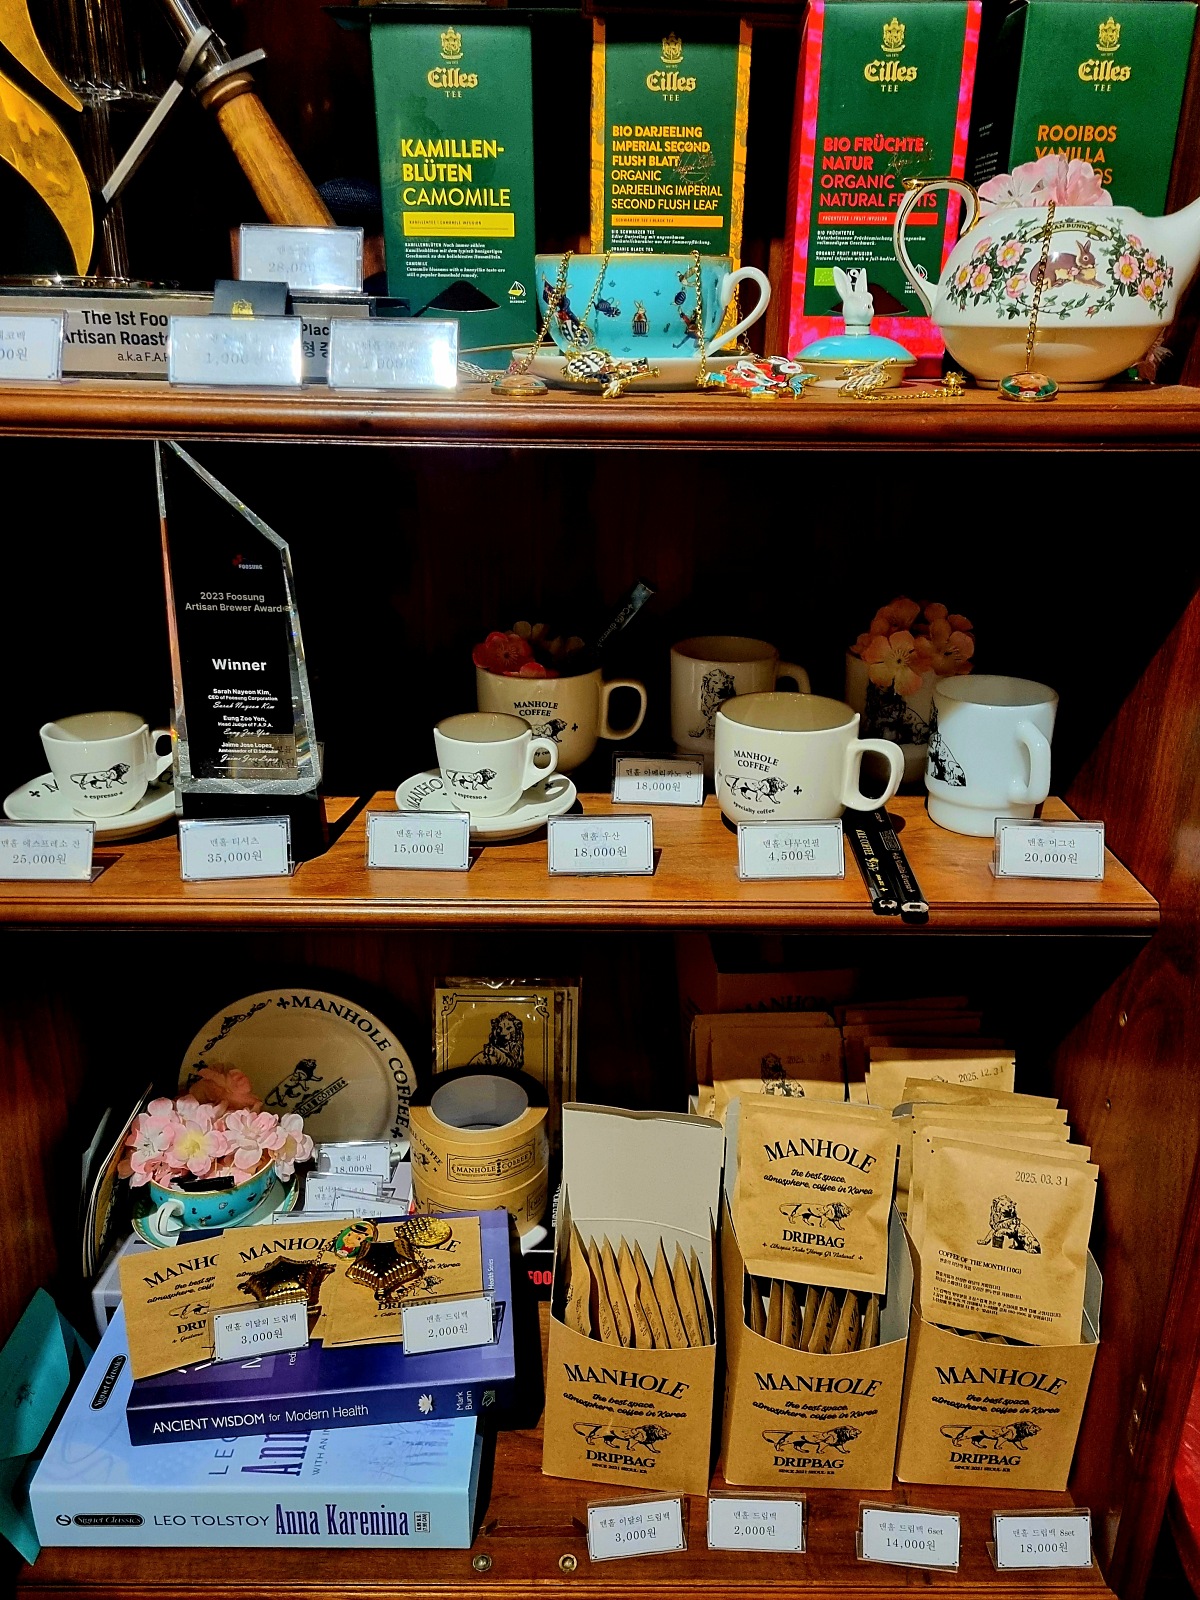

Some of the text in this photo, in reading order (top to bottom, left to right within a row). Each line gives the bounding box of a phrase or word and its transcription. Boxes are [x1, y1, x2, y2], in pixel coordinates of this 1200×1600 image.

[864, 60, 917, 82] Eilles
[1078, 59, 1131, 81] Eilles
[427, 67, 479, 88] Eilles
[646, 70, 697, 92] Eilles
[881, 84, 898, 92] TEE
[1094, 84, 1111, 92] TEE
[663, 94, 679, 102] TEE
[612, 126, 702, 138] BIO DARJEELING
[1037, 125, 1117, 141] ROOIBOS
[401, 139, 504, 158] KAMILLEN-
[612, 140, 710, 153] IMPERIAL SECOND
[823, 133, 925, 152] BIO FRÜCHTE
[612, 155, 680, 167] FLUSH BLATT
[822, 156, 874, 170] NATUR
[402, 160, 472, 182] BLÜTEN
[611, 170, 662, 181] ORGANIC
[820, 174, 895, 189] ORGANIC
[402, 187, 511, 207] CAMOMILE
[612, 184, 723, 197] DARJEELING IMPERIAL
[611, 199, 719, 211] SECOND FLUSH LEAF
[820, 193, 938, 207] NATURAL FRITS
[81, 310, 168, 327] The 1st Foo
[117, 352, 143, 362] a.k.a
[200, 592, 265, 603] 2023 Foosung
[185, 602, 218, 612] Artisan
[220, 603, 252, 612] Brewer
[212, 658, 267, 671] Winner
[232, 688, 256, 696] Nayeon
[513, 701, 559, 710] MANHOLE
[518, 709, 552, 717] COFFEE
[733, 750, 779, 767] MANHOLE
[737, 759, 771, 773] COFFEE
[643, 769, 681, 778] 아메리카노
[685, 770, 692, 779] 잔
[636, 781, 681, 792] 18,000원
[88, 792, 119, 801] espresso
[406, 778, 444, 810] MANHO
[396, 829, 442, 839] 맨홀 유리잔
[580, 831, 621, 841] 맨홀 우산
[22, 838, 68, 848] 에스프레소
[72, 839, 80, 849] 잔
[393, 843, 444, 855] 15,000원
[762, 838, 820, 849] 맨홀 나무연필
[1027, 838, 1075, 848] 맨홀 머그잔
[12, 853, 67, 865] 25,000원
[207, 849, 263, 863] 35,000원
[574, 845, 628, 859] 18,000원
[768, 848, 815, 862] 4,500원
[1024, 852, 1078, 865] 20,000원
[291, 995, 411, 1128] MANHOLE COFFEE
[763, 1138, 877, 1174] MANHOLE
[335, 1164, 372, 1173] 18,000원
[456, 1165, 496, 1174] MANHOLE
[790, 1169, 804, 1177] the
[805, 1171, 821, 1180] best
[812, 1183, 836, 1192] coffee
[837, 1185, 847, 1193] in
[847, 1186, 873, 1195] Korea
[782, 1229, 845, 1248] DRIPBAG
[238, 1237, 336, 1264] MANHOL
[938, 1250, 960, 1262] COFFEE
[961, 1255, 970, 1264] OF
[970, 1258, 983, 1267] THE
[983, 1260, 1006, 1272] MONTH
[1006, 1265, 1022, 1275] (10G)
[142, 1253, 220, 1289] MANH
[245, 1317, 269, 1330] 이달의
[273, 1312, 297, 1325] 드립백
[241, 1328, 283, 1345] 3,000원
[428, 1323, 468, 1338] 2,000원
[563, 1362, 690, 1400] MANHOLE
[754, 1372, 883, 1398] MANHOLE
[934, 1366, 1068, 1395] MANHOLE
[153, 1404, 369, 1434] ANCIENT WISDOM for Modern Health
[586, 1449, 656, 1468] DRIPBAG
[772, 1456, 844, 1469] DRIPBAG
[949, 1451, 1022, 1466] DRIPBAG
[78, 1516, 141, 1525] Signet Classics
[153, 1514, 270, 1527] LEO TOLSTOY
[275, 1504, 320, 1536] Anna
[325, 1504, 409, 1536] Karenina
[599, 1511, 670, 1529] 맨홀 이달의 드립백
[733, 1510, 777, 1521] 맨홀 드립백
[615, 1527, 657, 1544] 3,000원
[734, 1525, 776, 1537] 2,000원
[879, 1521, 944, 1536] 맨홀 드립백 6set
[1012, 1527, 1075, 1538] 맨홀 드립백 8set
[885, 1537, 936, 1552] 14,000원
[1019, 1541, 1068, 1554] 18,000원
